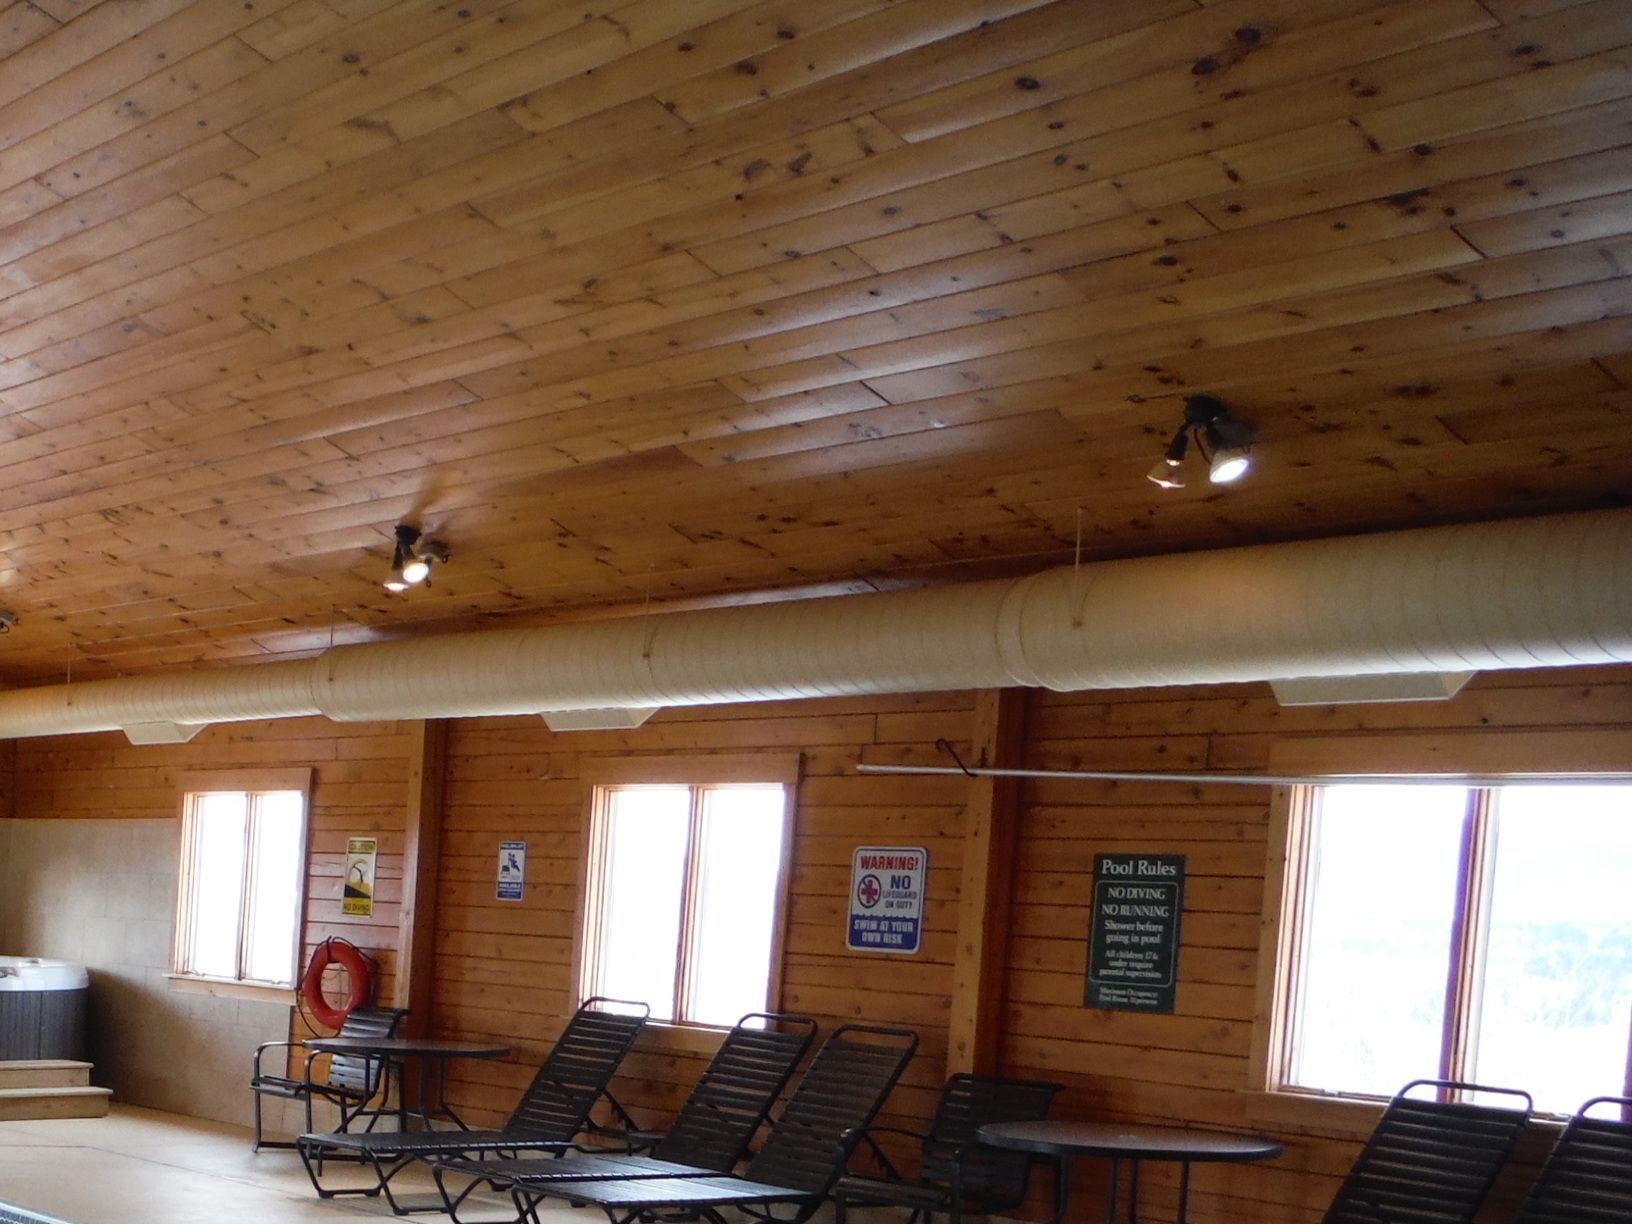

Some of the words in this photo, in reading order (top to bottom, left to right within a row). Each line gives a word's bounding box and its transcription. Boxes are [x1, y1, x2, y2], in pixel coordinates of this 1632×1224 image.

[860, 855, 919, 871] WARNING!
[1101, 859, 1134, 875] Pool
[1136, 859, 1177, 877] Rules
[890, 874, 912, 890] NO
[882, 890, 917, 900] LIFEGUARD
[1107, 887, 1125, 899] NO
[1126, 887, 1167, 900] DIVING
[884, 899, 895, 909] ON
[896, 900, 913, 910] DUTY
[1100, 903, 1119, 916] NO
[1120, 904, 1170, 918] RUNNING
[853, 919, 878, 931] SWIM
[878, 920, 890, 932] AT
[890, 920, 915, 933] YOUR
[1103, 919, 1135, 931] Shower
[1136, 920, 1165, 933] before
[861, 931, 882, 943] OWN
[882, 932, 903, 945] RISK
[1105, 933, 1130, 945] going
[1130, 932, 1140, 943] in
[1140, 933, 1161, 947] pool
